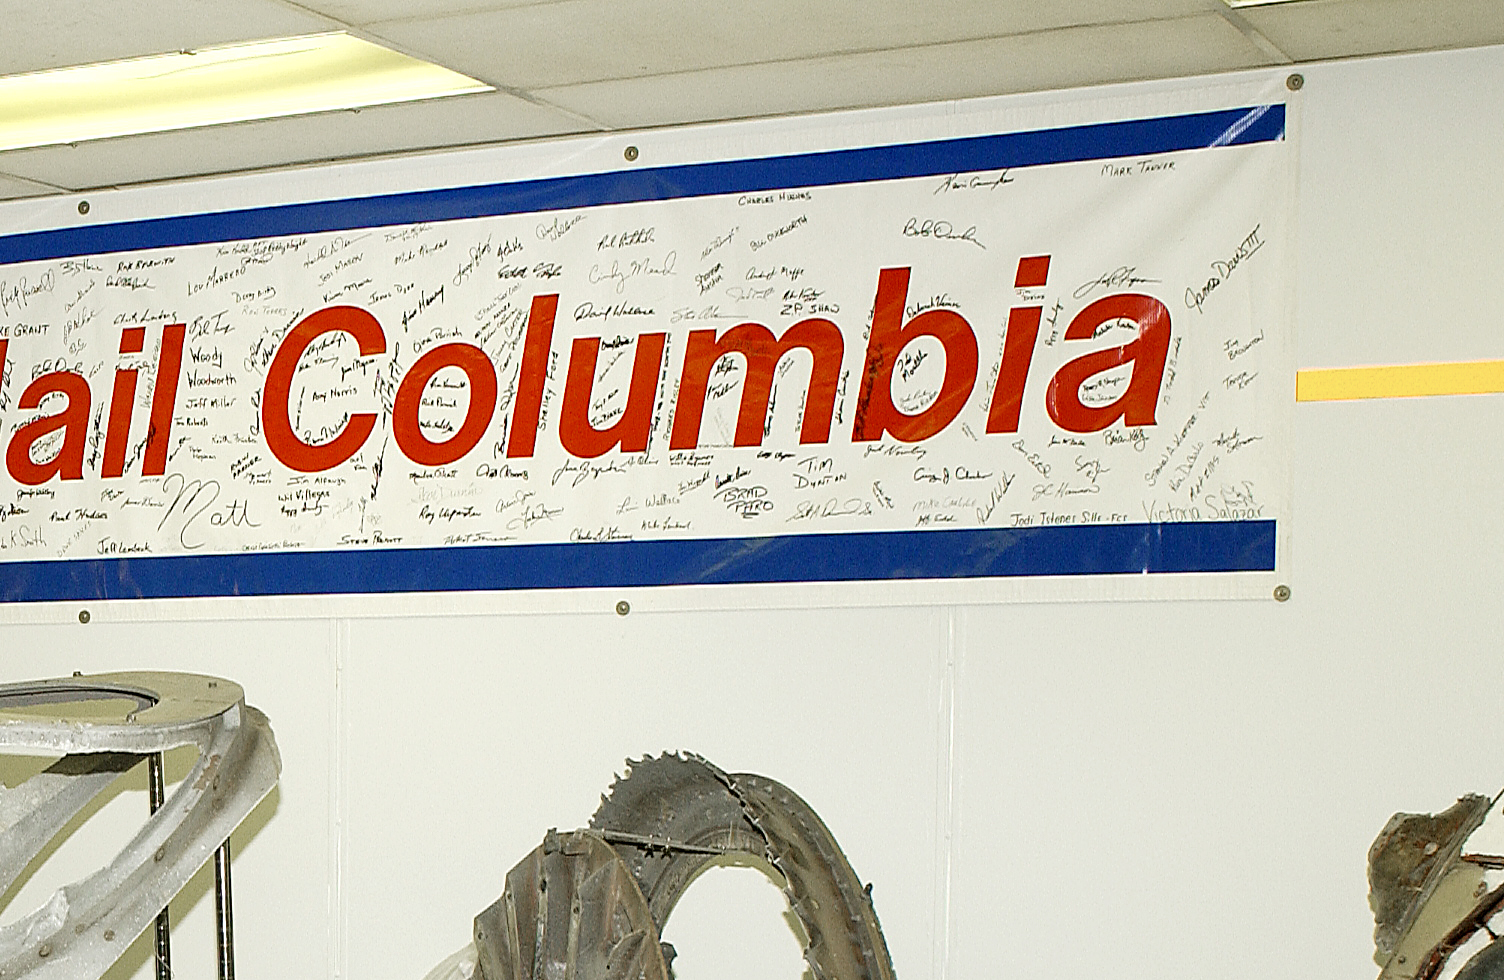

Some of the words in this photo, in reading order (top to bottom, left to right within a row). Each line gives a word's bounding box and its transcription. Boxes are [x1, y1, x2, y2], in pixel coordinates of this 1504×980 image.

[1101, 163, 1132, 177] MARK
[13, 323, 50, 337] GRANT
[190, 346, 222, 368] Woody
[262, 255, 1173, 473] Columbia
[187, 369, 236, 389] Woodworth
[797, 457, 833, 473] TIM
